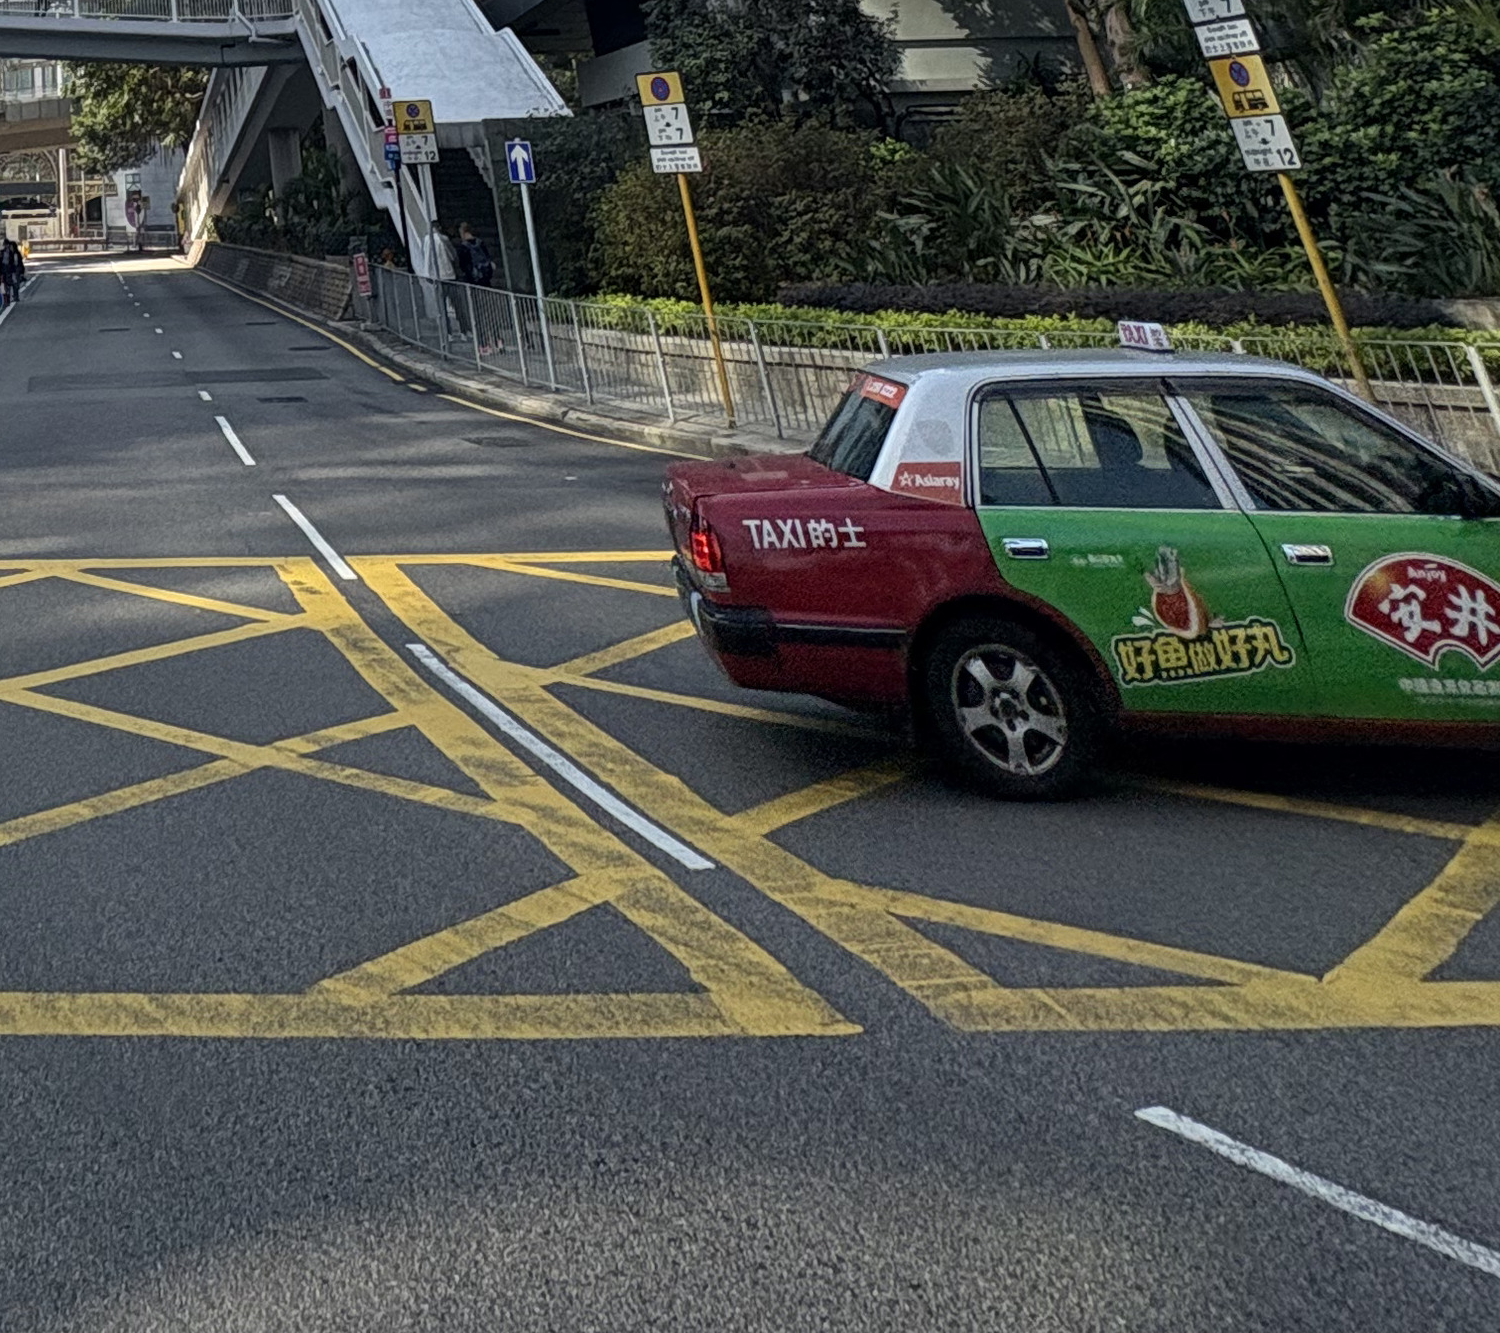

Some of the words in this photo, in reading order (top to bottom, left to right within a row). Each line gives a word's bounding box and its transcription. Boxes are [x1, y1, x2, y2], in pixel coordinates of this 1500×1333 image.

[671, 106, 678, 120] 7
[675, 128, 683, 140] 7
[1263, 119, 1275, 136] 7
[421, 135, 428, 146] 7
[424, 151, 436, 161] 12
[1276, 147, 1297, 166] 12
[742, 518, 806, 549] TAXI
[806, 517, 867, 548] 的士
[1377, 583, 1500, 647] 安井
[1118, 623, 1290, 681] 好魚做好丸
